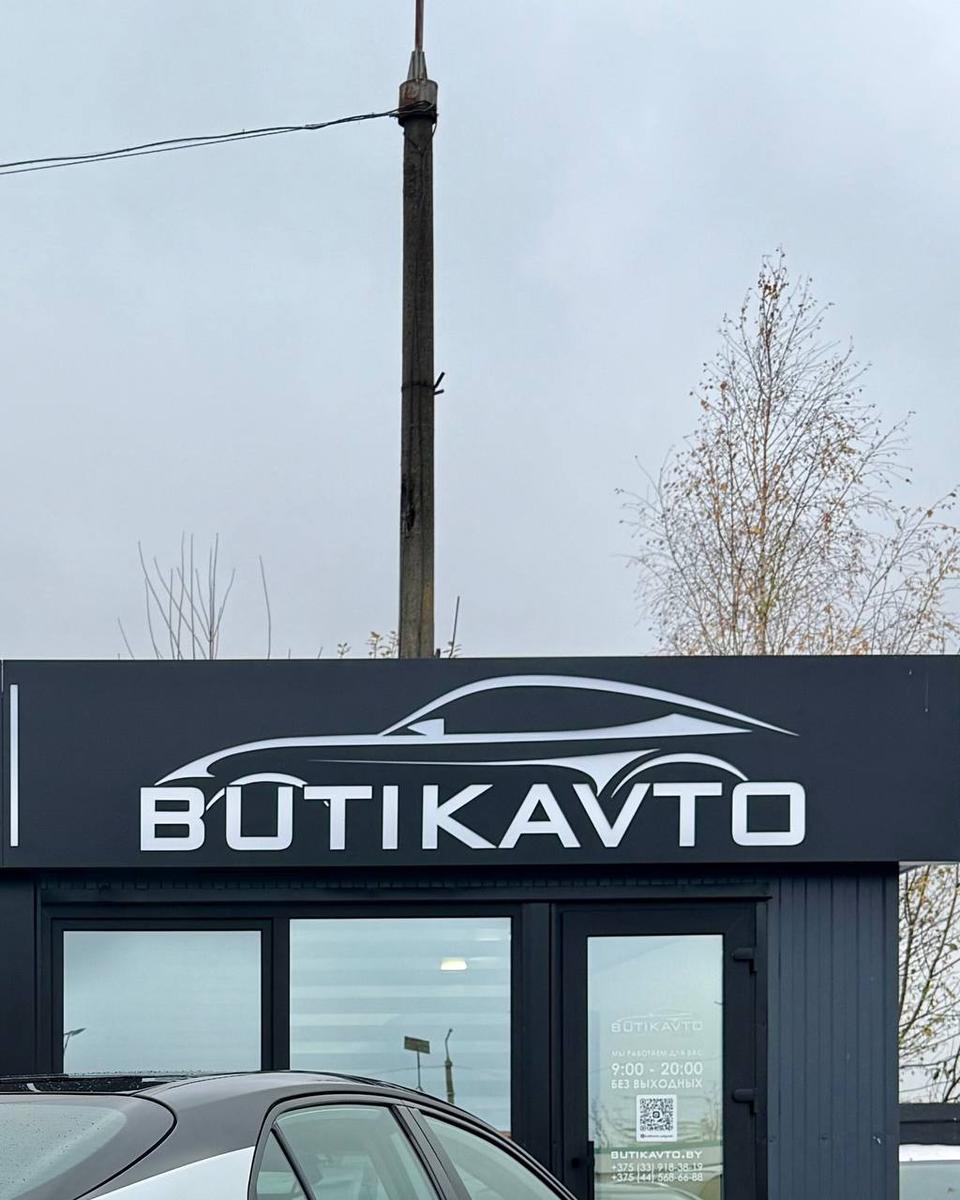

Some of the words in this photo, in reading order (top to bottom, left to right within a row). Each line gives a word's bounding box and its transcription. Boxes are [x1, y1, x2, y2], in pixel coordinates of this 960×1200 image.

[139, 781, 806, 851] BUTIKAVTO
[610, 1020, 703, 1033] BUTIKAVTO
[611, 1062, 644, 1076] 9:00
[660, 1061, 703, 1076] 20:00
[611, 1079, 630, 1089] БЕЗ
[633, 1078, 703, 1089] ВЫХОДНЫХ
[610, 1150, 703, 1159] BUTIKAVTO.BY
[612, 1163, 634, 1172] +375
[637, 1162, 655, 1173] (33)
[657, 1162, 703, 1172] 918-38-19
[612, 1173, 634, 1182] +375
[637, 1172, 655, 1183] (44)
[657, 1173, 703, 1182] 568-66-88
